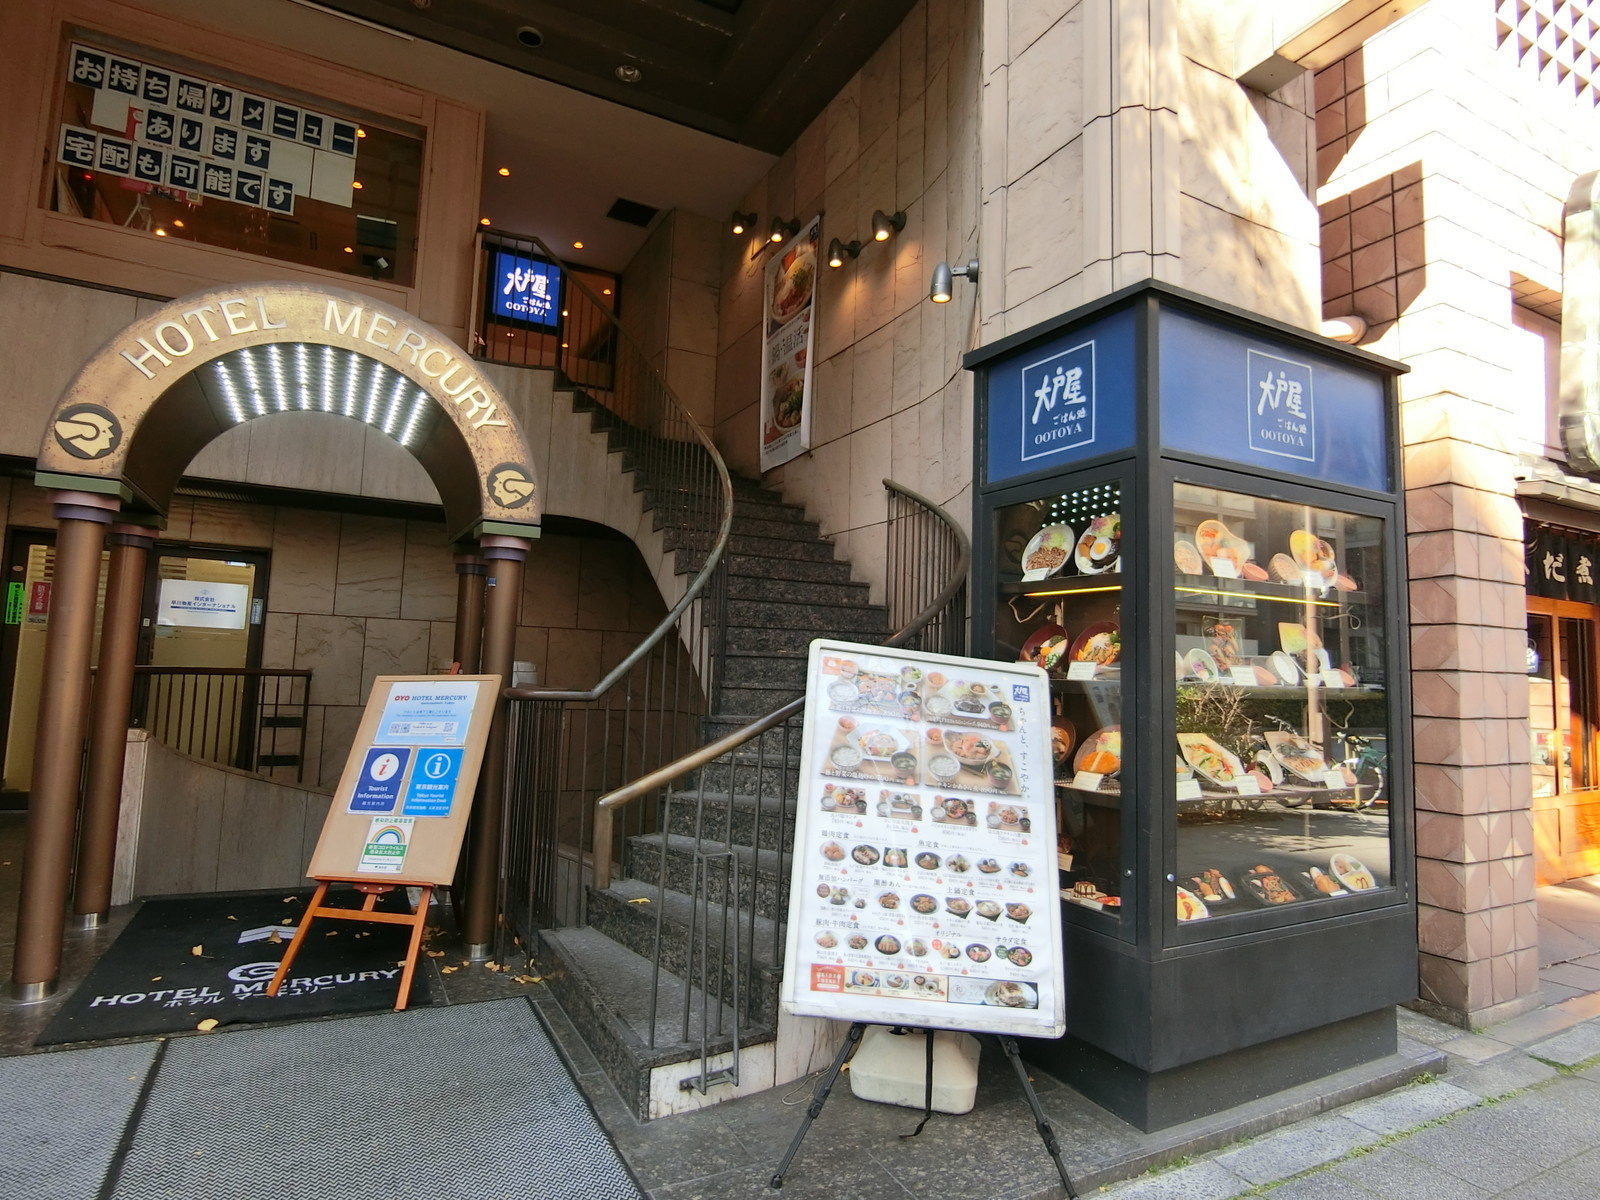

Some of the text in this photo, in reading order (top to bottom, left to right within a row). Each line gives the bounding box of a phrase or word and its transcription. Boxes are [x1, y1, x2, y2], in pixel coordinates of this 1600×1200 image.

[75, 56, 354, 142] お持ち帰りメニュー
[147, 116, 270, 163] あります
[64, 135, 292, 206] 宅配も可能です
[505, 301, 548, 317] OOTOYA
[119, 296, 508, 432] HOTEL MERCURY
[1031, 365, 1087, 425] 大戸屋
[1256, 370, 1307, 420] 大戸屋
[1033, 423, 1083, 446] OOTOYA
[1260, 427, 1305, 448] OOTOYA
[89, 985, 221, 1008] HOTEL
[162, 996, 225, 1008] ホテル
